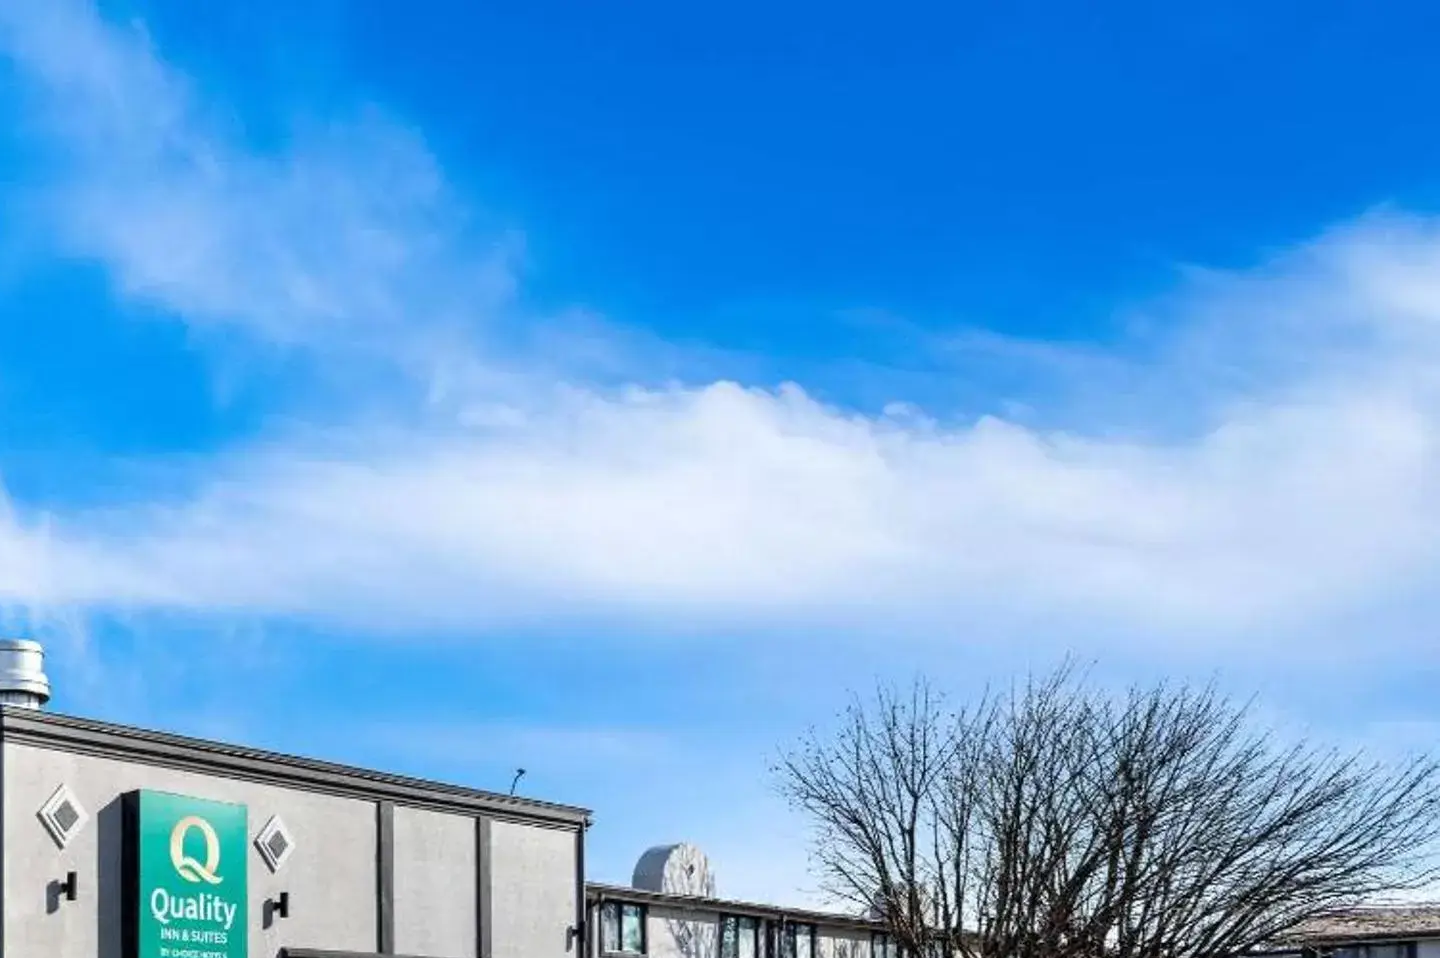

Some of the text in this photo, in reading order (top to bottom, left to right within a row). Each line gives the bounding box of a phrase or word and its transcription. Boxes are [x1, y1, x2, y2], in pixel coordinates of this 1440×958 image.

[170, 816, 224, 884] Q
[151, 888, 237, 929] Quality
[160, 927, 179, 940] INN
[191, 930, 228, 944] SUITES
